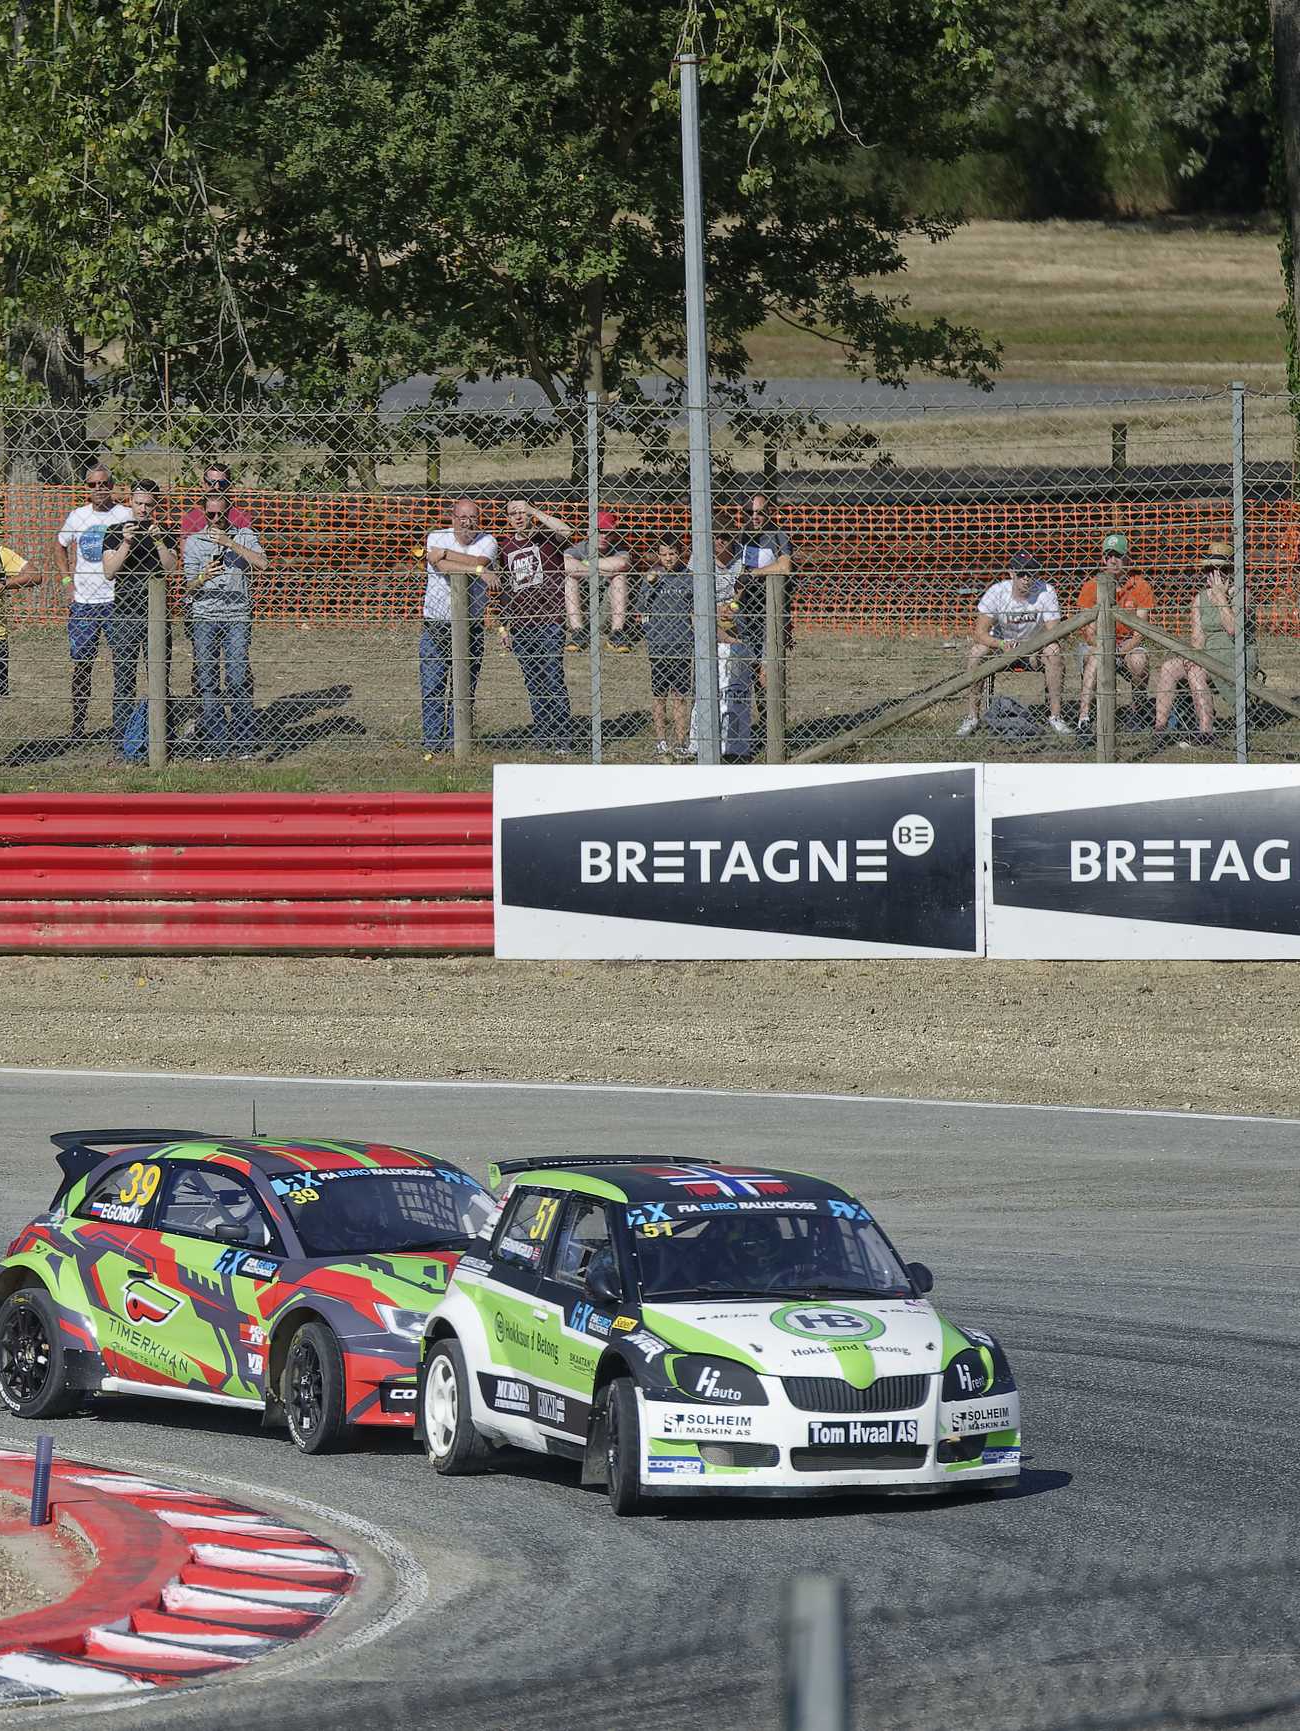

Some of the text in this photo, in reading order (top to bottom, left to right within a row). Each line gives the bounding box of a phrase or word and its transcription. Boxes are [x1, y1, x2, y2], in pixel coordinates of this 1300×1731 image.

[898, 826, 929, 844] BE
[580, 840, 888, 883] BRETAGNE
[317, 1172, 340, 1181] FIA
[338, 1168, 371, 1178] EURO
[371, 1168, 436, 1177] RALLYCROSS
[120, 1163, 161, 1206] 39
[288, 1187, 320, 1205] 39
[99, 1203, 144, 1224] EGOROV
[677, 1204, 700, 1213] FIA
[700, 1201, 738, 1212] EURO
[738, 1201, 818, 1212] RALLYCROSS
[530, 1197, 561, 1240] 51
[643, 1223, 674, 1238] 51
[793, 1313, 864, 1329] HB
[108, 1317, 189, 1374] TIMERKHAN
[536, 1333, 559, 1366] Betong
[791, 1343, 859, 1358] Hokksund
[712, 1387, 742, 1400] auto
[687, 1414, 752, 1426] SOLHEIM
[968, 1406, 1010, 1420] SOLHEIM
[685, 1427, 752, 1436] MASKIN AS
[810, 1420, 917, 1443] Tom Hvaal AS
[968, 1420, 1010, 1430] MASKIN AS
[648, 1460, 701, 1470] COOPER
